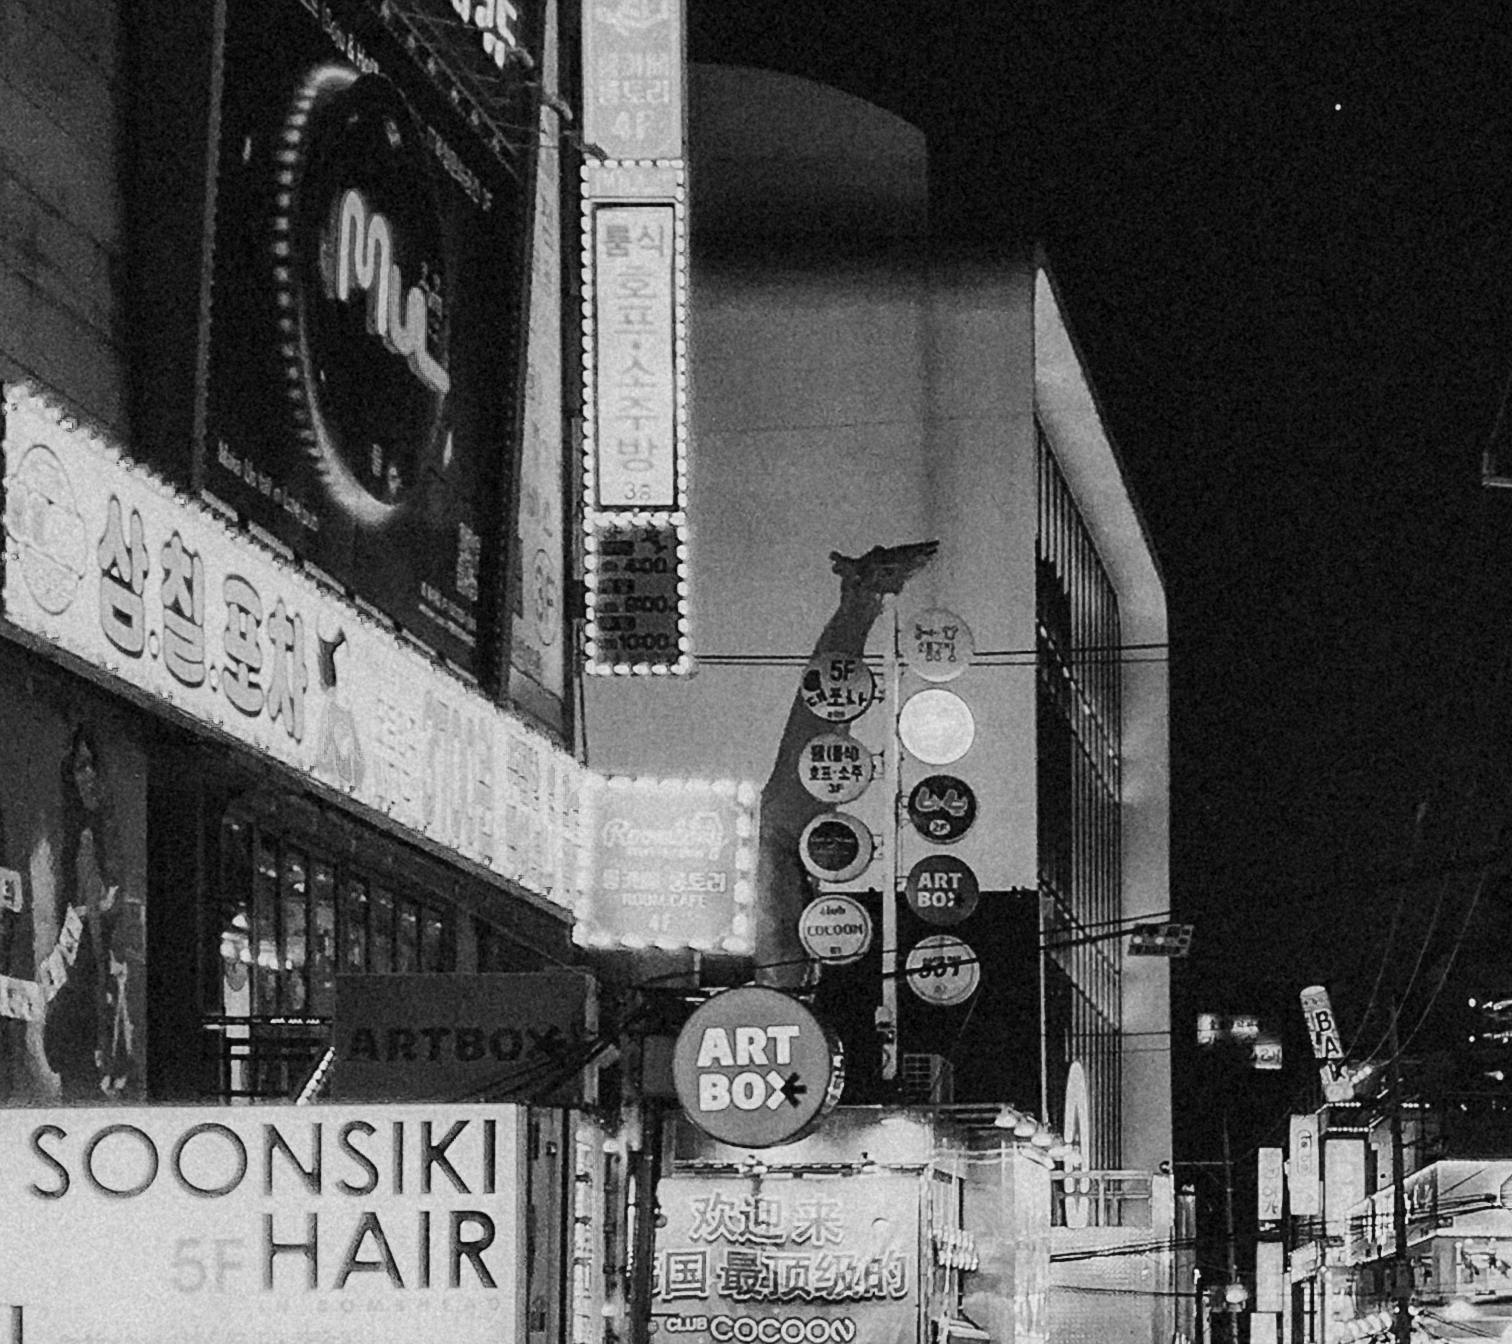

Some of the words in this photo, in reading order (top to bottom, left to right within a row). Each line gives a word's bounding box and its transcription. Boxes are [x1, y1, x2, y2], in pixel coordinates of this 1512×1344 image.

[830, 659, 856, 682] 5F
[917, 872, 963, 889] ART
[807, 924, 864, 937] COCOON
[697, 1025, 800, 1067] ART
[28, 1119, 497, 1200] SOONSIKI
[688, 1191, 847, 1247] 欢迎来
[172, 1237, 245, 1294] 5F
[260, 1210, 499, 1290] HAIR
[652, 1248, 910, 1306] 国最顶级的
[664, 1315, 708, 1334] CLUB
